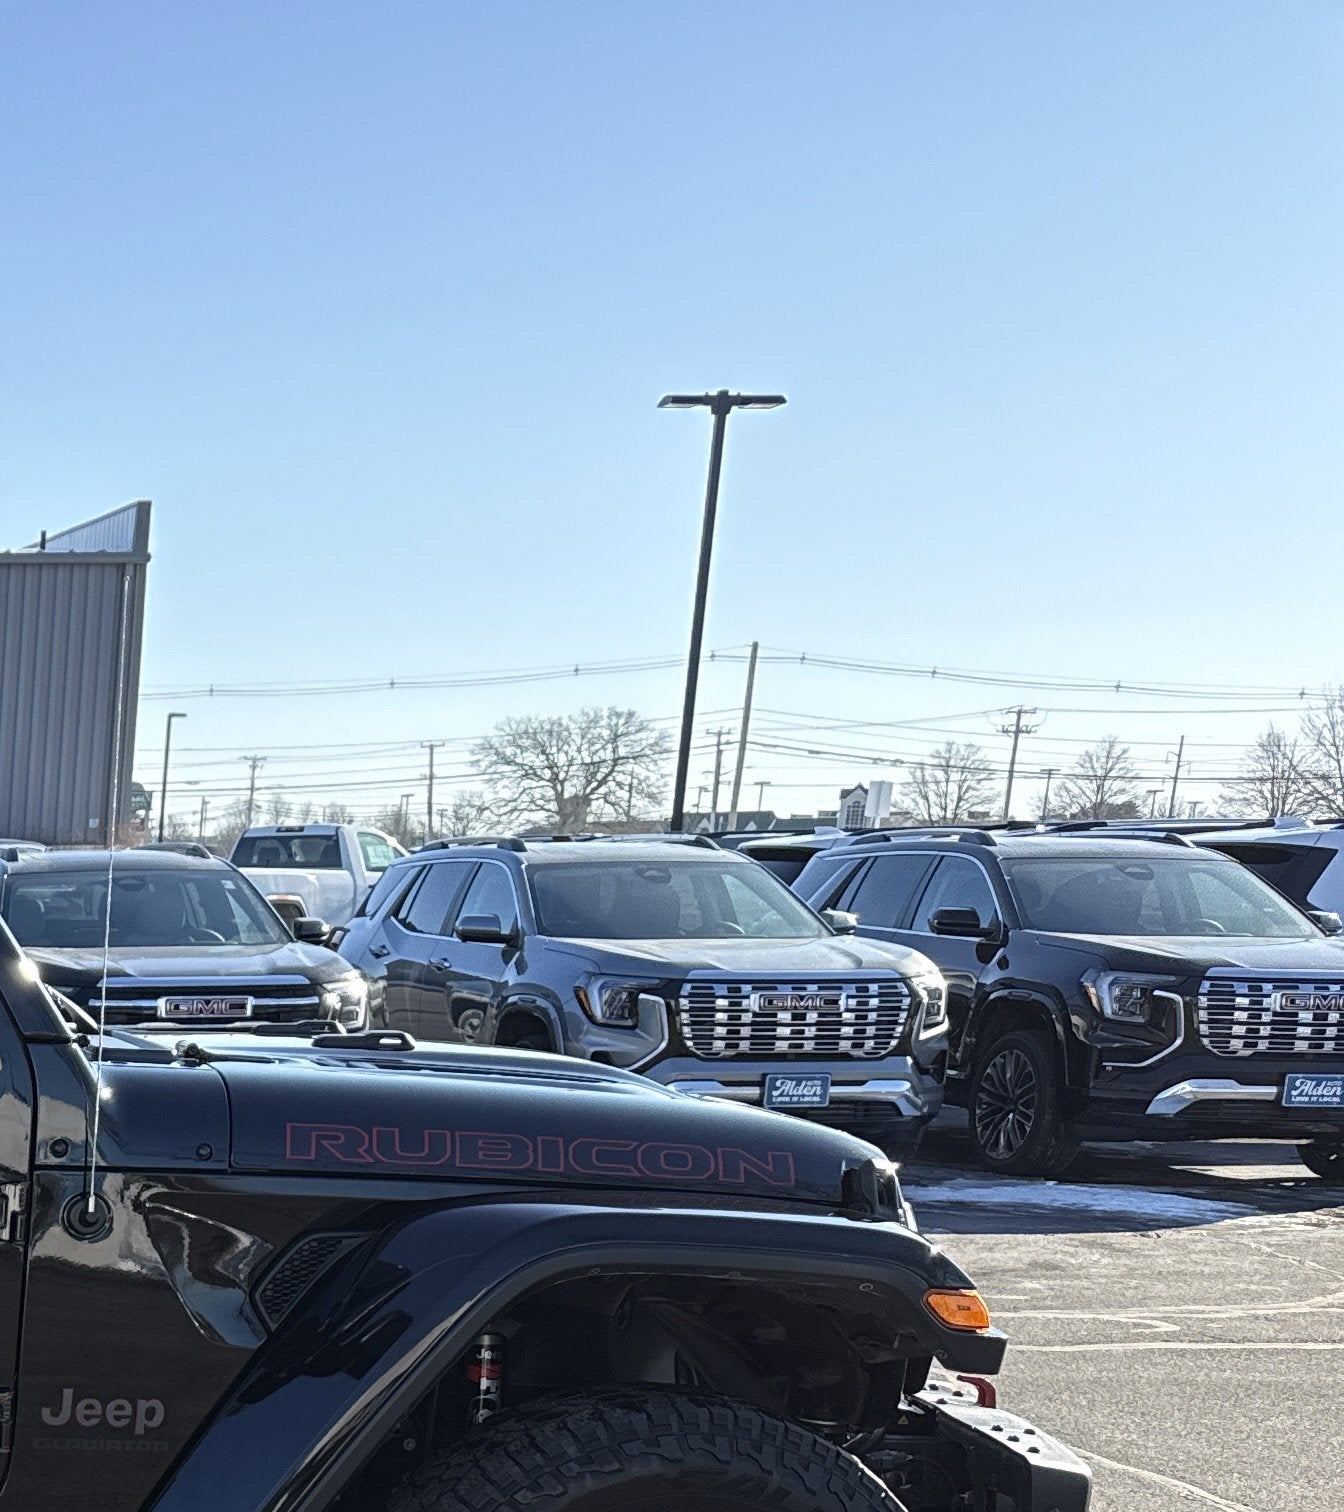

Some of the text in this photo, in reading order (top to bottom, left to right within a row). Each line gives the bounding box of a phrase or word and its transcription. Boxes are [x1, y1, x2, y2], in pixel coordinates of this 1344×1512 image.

[167, 999, 247, 1014] GMC
[761, 995, 839, 1010] GMC
[1282, 995, 1344, 1011] GM
[772, 1079, 822, 1096] Alden
[1291, 1079, 1344, 1095] Alden
[286, 1122, 796, 1187] RUBICON
[41, 1388, 165, 1436] Jeep
[32, 1438, 170, 1452] GLADIATOR
